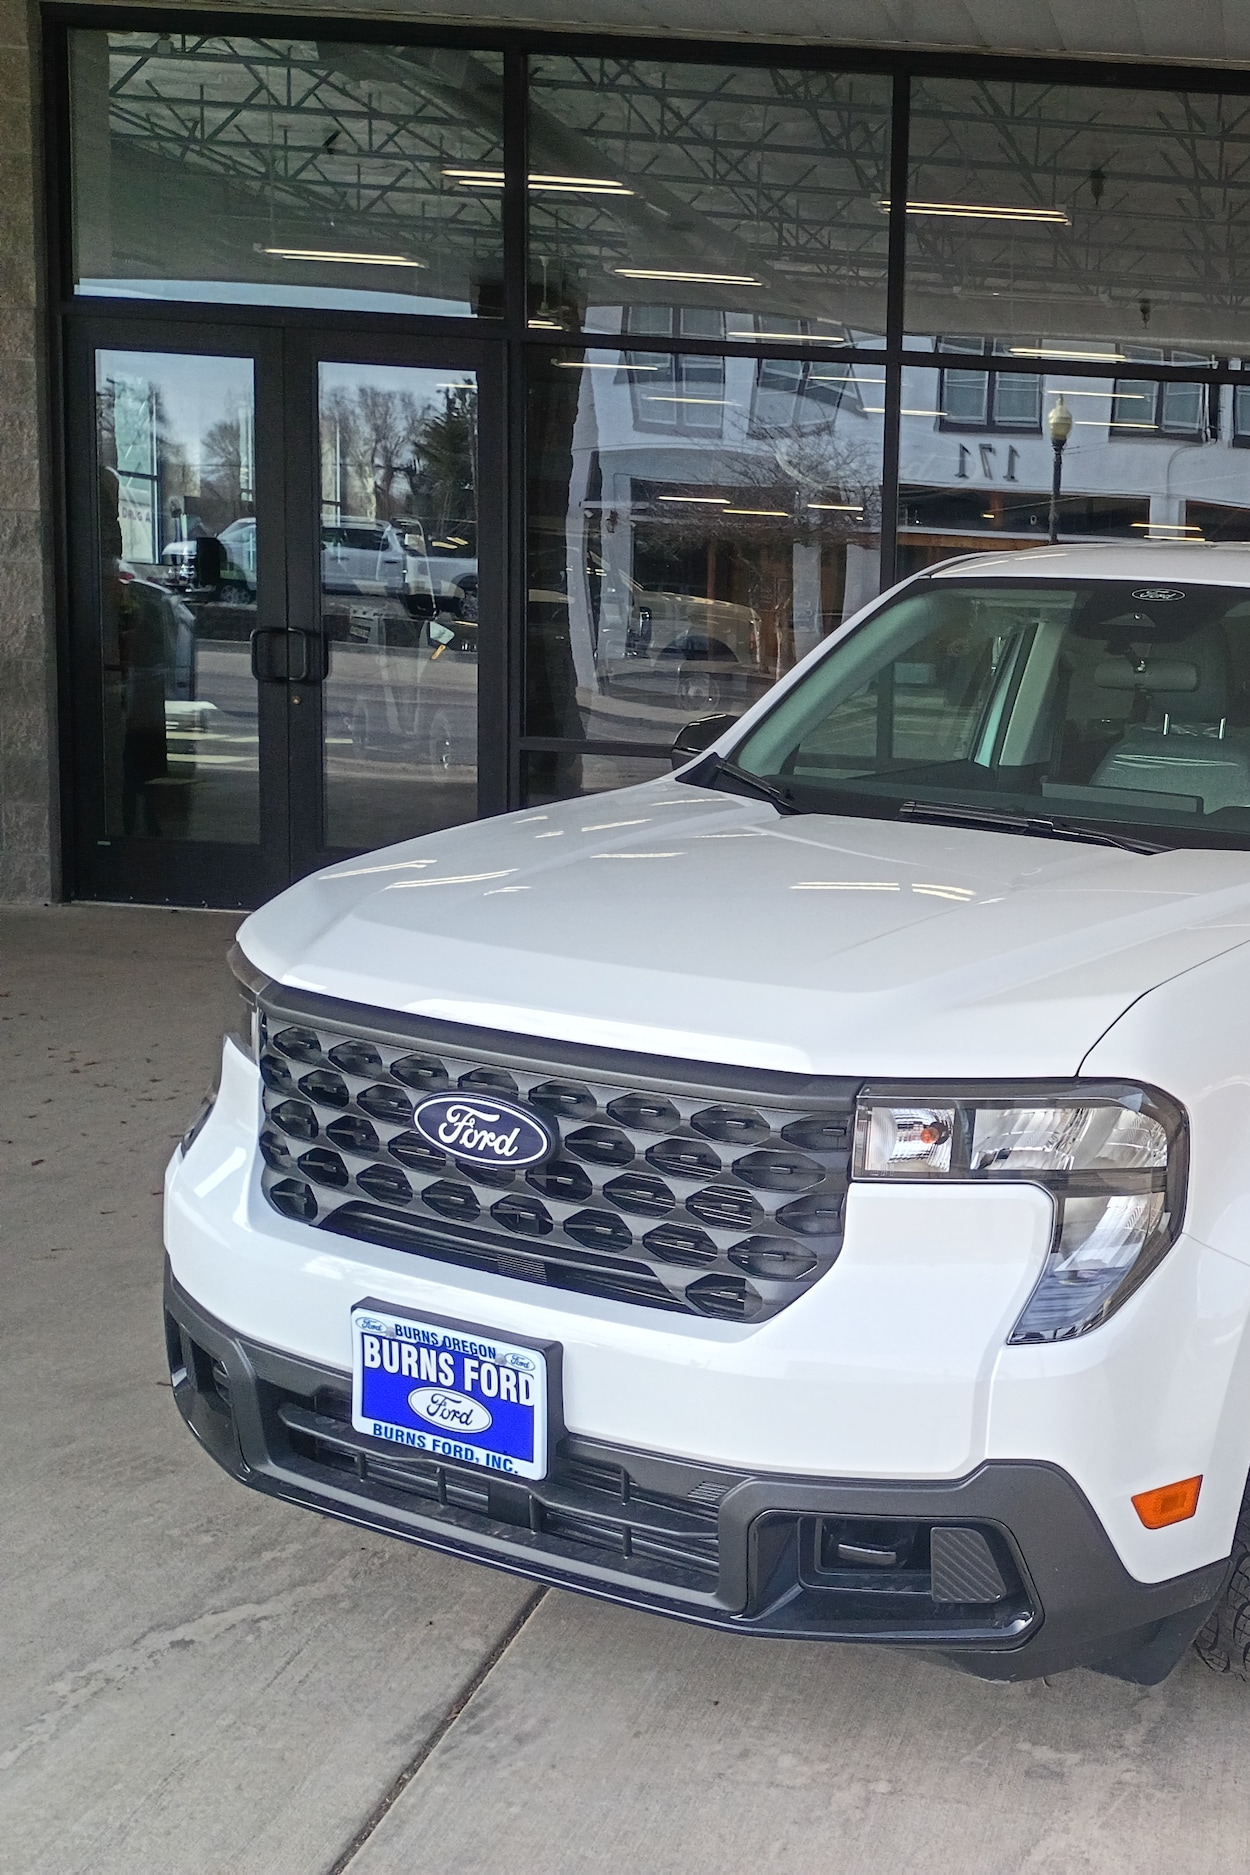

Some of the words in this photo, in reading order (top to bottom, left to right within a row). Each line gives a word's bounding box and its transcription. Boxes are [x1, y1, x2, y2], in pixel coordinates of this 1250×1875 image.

[438, 1105, 520, 1156] Ford
[362, 1318, 382, 1331] Ford
[394, 1324, 439, 1345] BURNS
[442, 1336, 496, 1359] OREGON
[363, 1334, 455, 1387] BURNS
[463, 1357, 535, 1407] FORD
[511, 1354, 530, 1368] Ford
[426, 1392, 473, 1426] Ford
[373, 1423, 426, 1448] BURNS
[432, 1439, 479, 1463] FORD,
[486, 1453, 518, 1474] INC.
